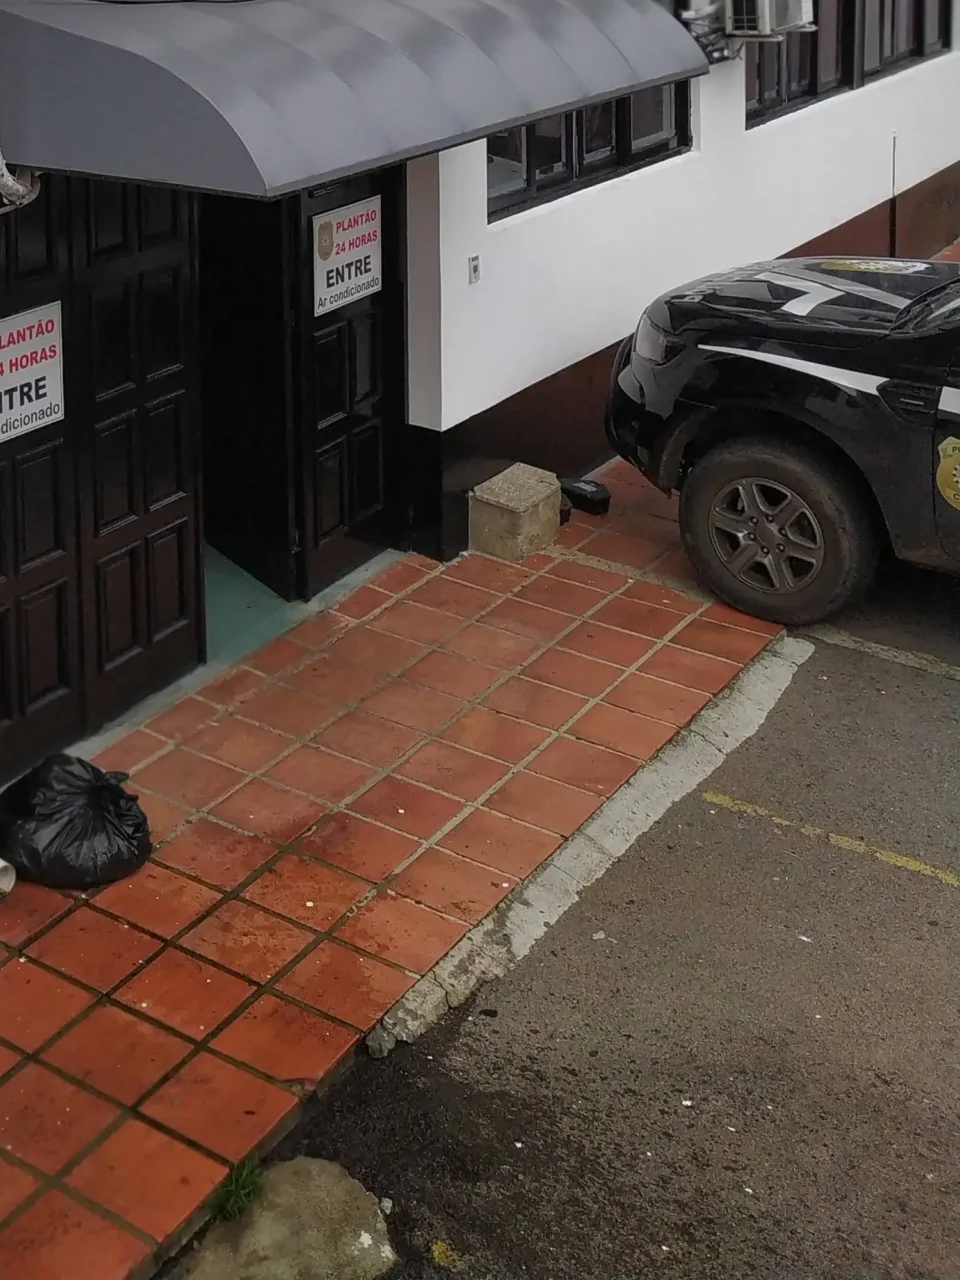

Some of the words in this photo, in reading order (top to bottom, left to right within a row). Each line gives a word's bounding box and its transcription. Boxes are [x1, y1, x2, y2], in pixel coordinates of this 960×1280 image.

[335, 209, 377, 234] PLANTÃO
[335, 243, 346, 256] 24
[348, 229, 378, 251] HORAS
[326, 254, 372, 289] ENTRE
[317, 296, 328, 310] Ar
[329, 275, 380, 305] condicionado
[9, 344, 58, 374] HORAS
